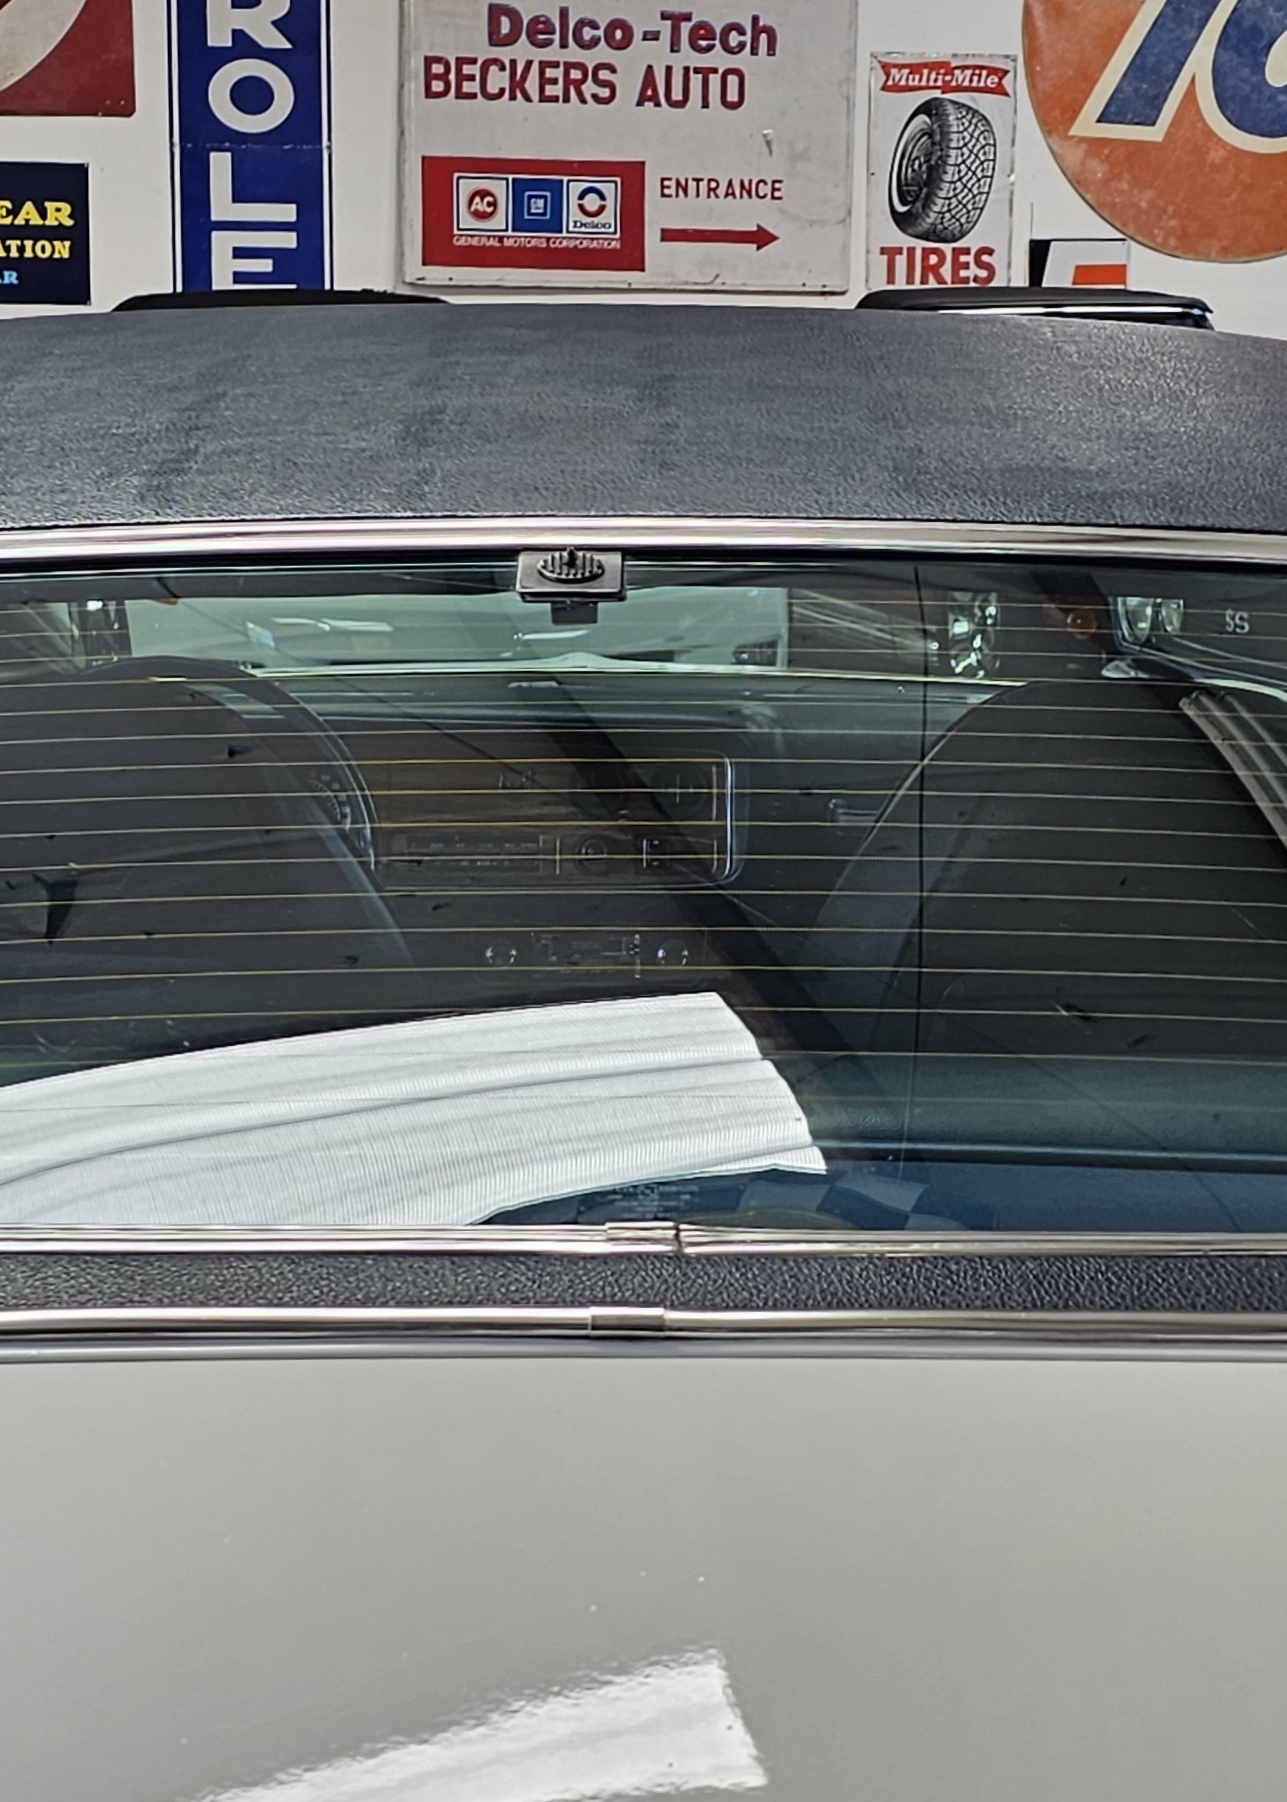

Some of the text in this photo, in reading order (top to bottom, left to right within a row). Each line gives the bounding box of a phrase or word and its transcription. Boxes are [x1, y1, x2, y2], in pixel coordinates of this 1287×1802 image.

[424, 55, 746, 111] BECKERS AUTO
[887, 68, 999, 88] Multi-Mile
[660, 177, 784, 200] ENTRANCE
[470, 195, 495, 213] AC
[572, 219, 612, 231] Delco
[453, 236, 621, 250] GENERAL MOTORS CORPORATION
[879, 246, 996, 287] TIRES
